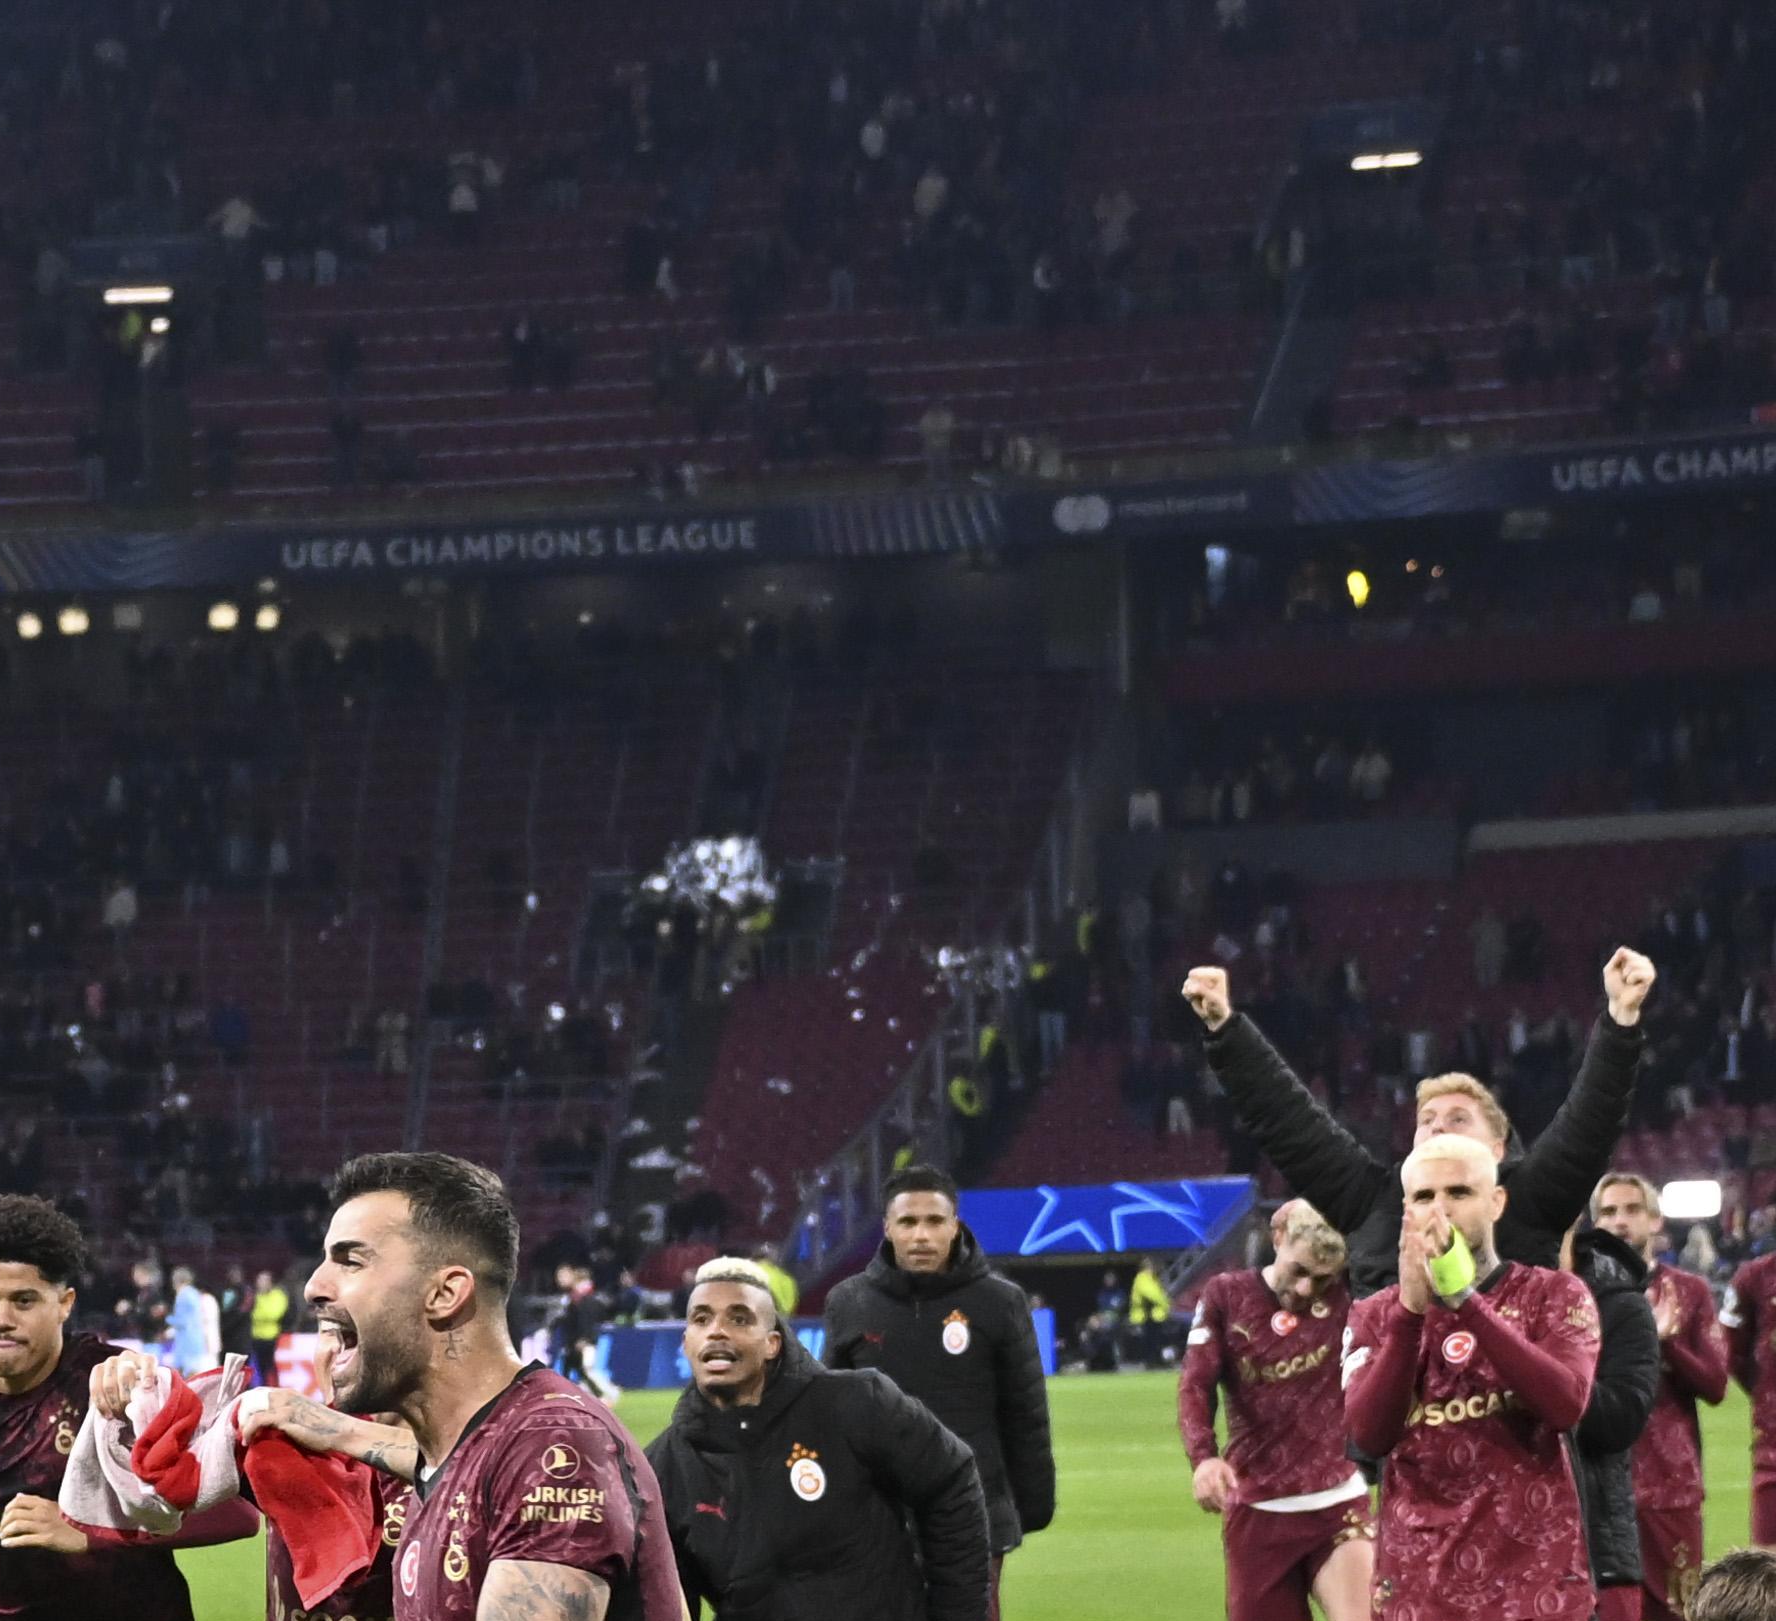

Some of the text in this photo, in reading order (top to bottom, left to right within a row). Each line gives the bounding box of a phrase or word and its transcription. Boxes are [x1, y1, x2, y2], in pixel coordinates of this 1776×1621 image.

[1551, 456, 1642, 491] UEFA
[282, 520, 757, 569] UEFA CHAMPIONS LEAGUE
[1424, 1390, 1513, 1426] SOCA
[522, 1486, 605, 1506] URKISH
